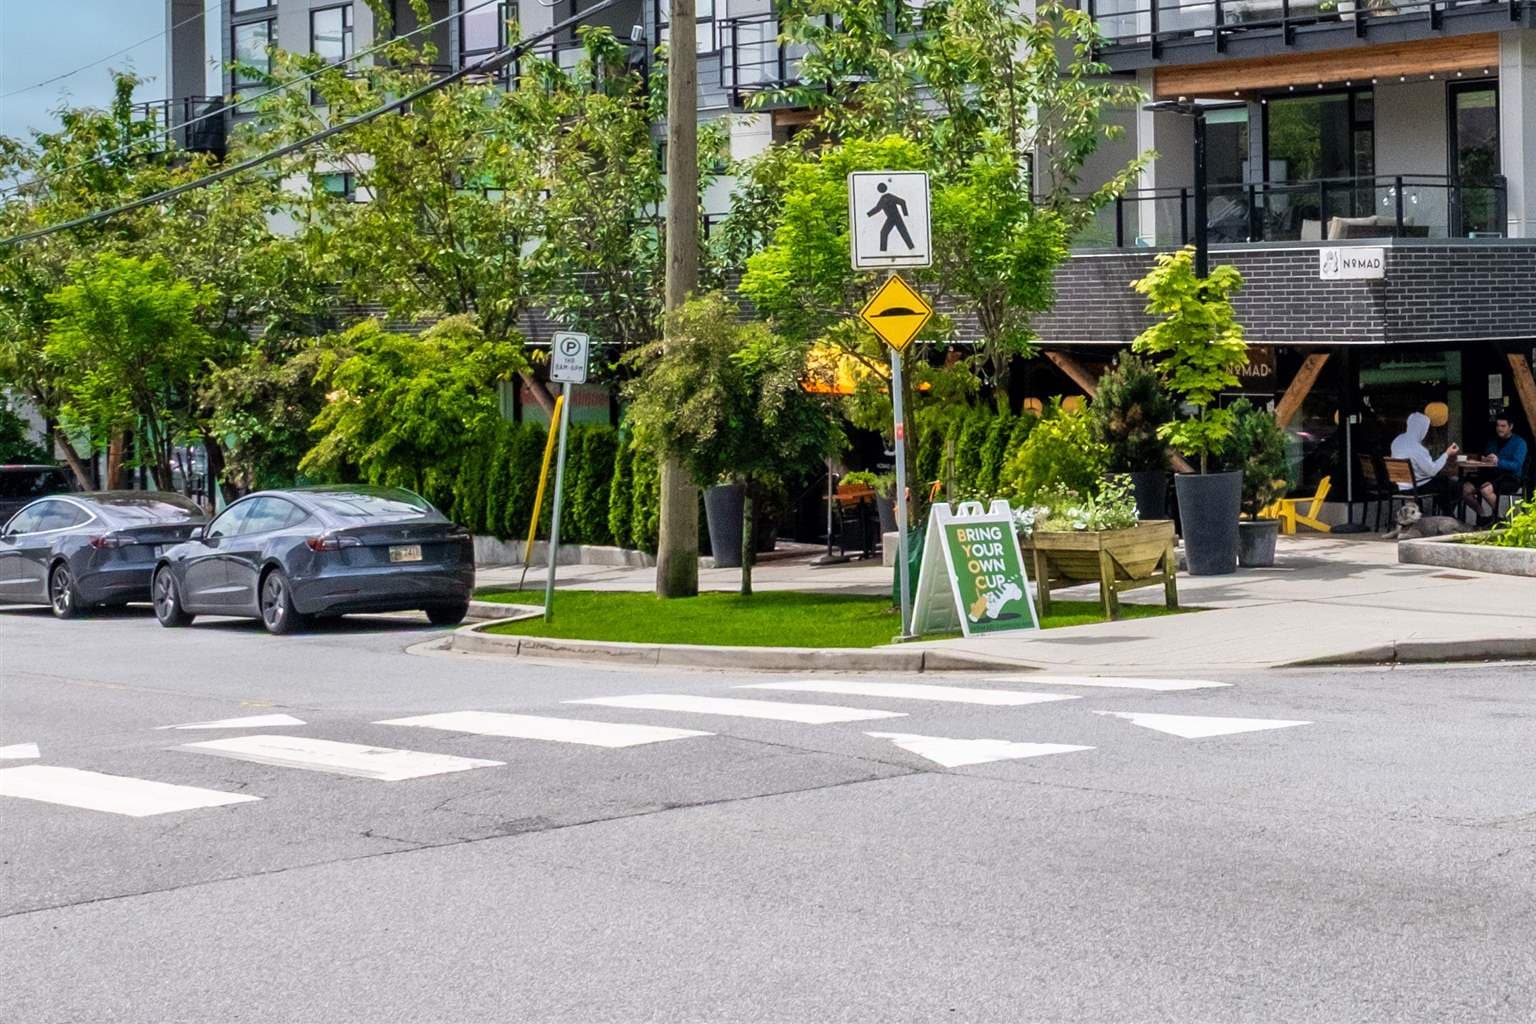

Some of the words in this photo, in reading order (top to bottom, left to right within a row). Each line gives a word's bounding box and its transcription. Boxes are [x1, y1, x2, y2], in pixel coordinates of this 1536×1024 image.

[566, 342, 576, 352] P
[957, 527, 1002, 542] BRING
[962, 543, 1004, 557] YOUR
[968, 559, 1005, 573] OWN
[975, 575, 1005, 589] CUP
